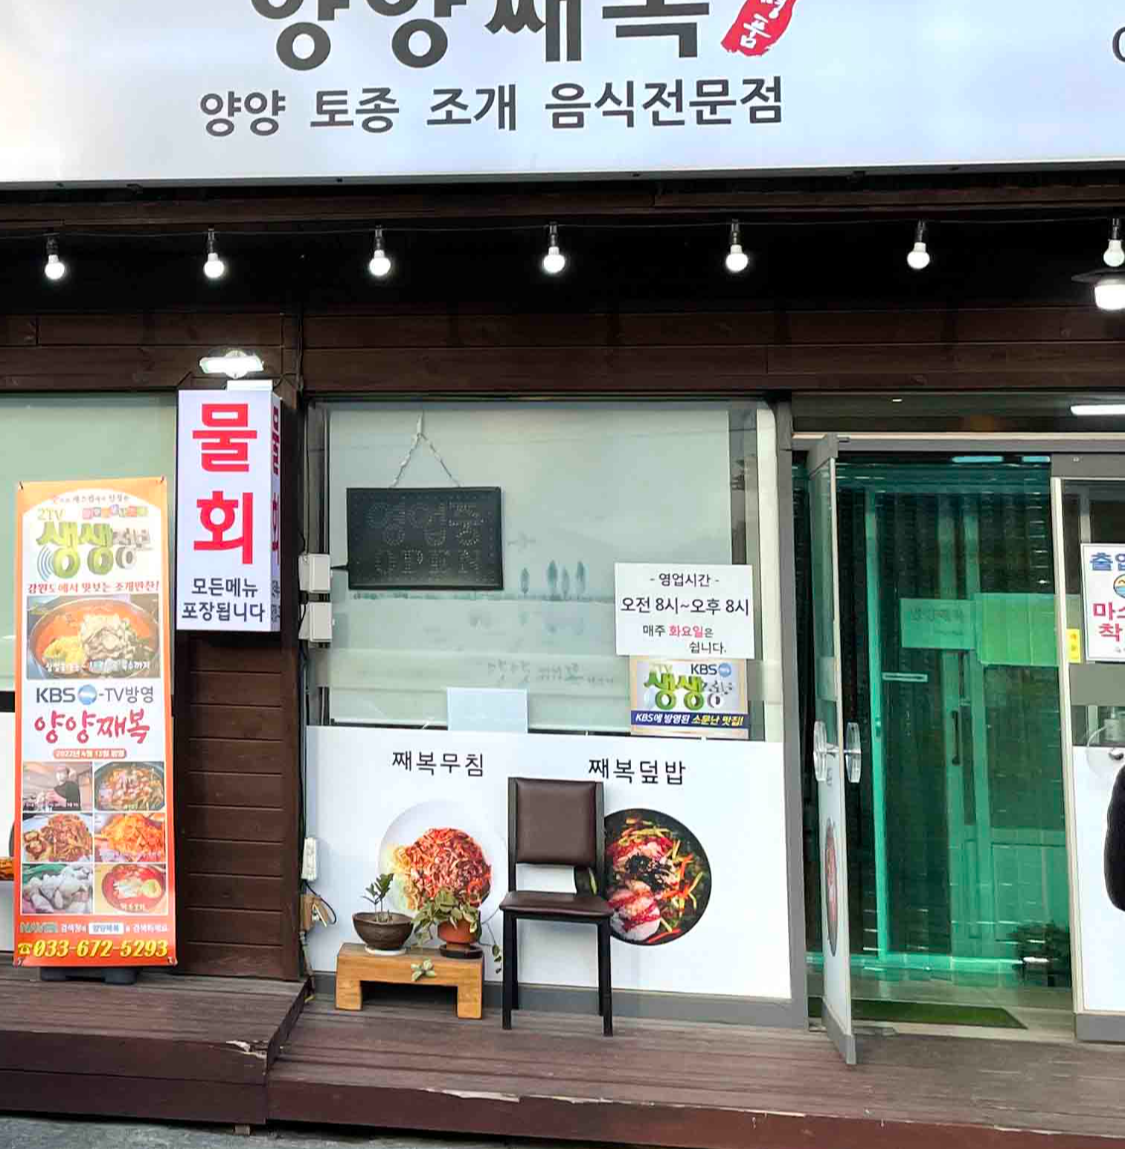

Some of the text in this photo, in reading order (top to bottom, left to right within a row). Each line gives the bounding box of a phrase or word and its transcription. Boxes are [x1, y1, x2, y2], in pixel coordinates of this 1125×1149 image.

[200, 75, 784, 137] 양양 토종 조개 음식전문점
[192, 403, 257, 564] 물회
[192, 578, 258, 598] 모든메뉴
[659, 573, 711, 588] 영업시간
[182, 602, 265, 623] 포장됩니다
[620, 597, 651, 613] 오전
[725, 599, 750, 616] 8시
[643, 624, 666, 637] 매주
[691, 663, 718, 676] KBS
[36, 687, 76, 704] KBS
[34, 708, 150, 744] 양양째복
[392, 750, 484, 777] 째복무침
[588, 757, 686, 786] 째복덮밥
[33, 940, 169, 958] 033-672-5293
